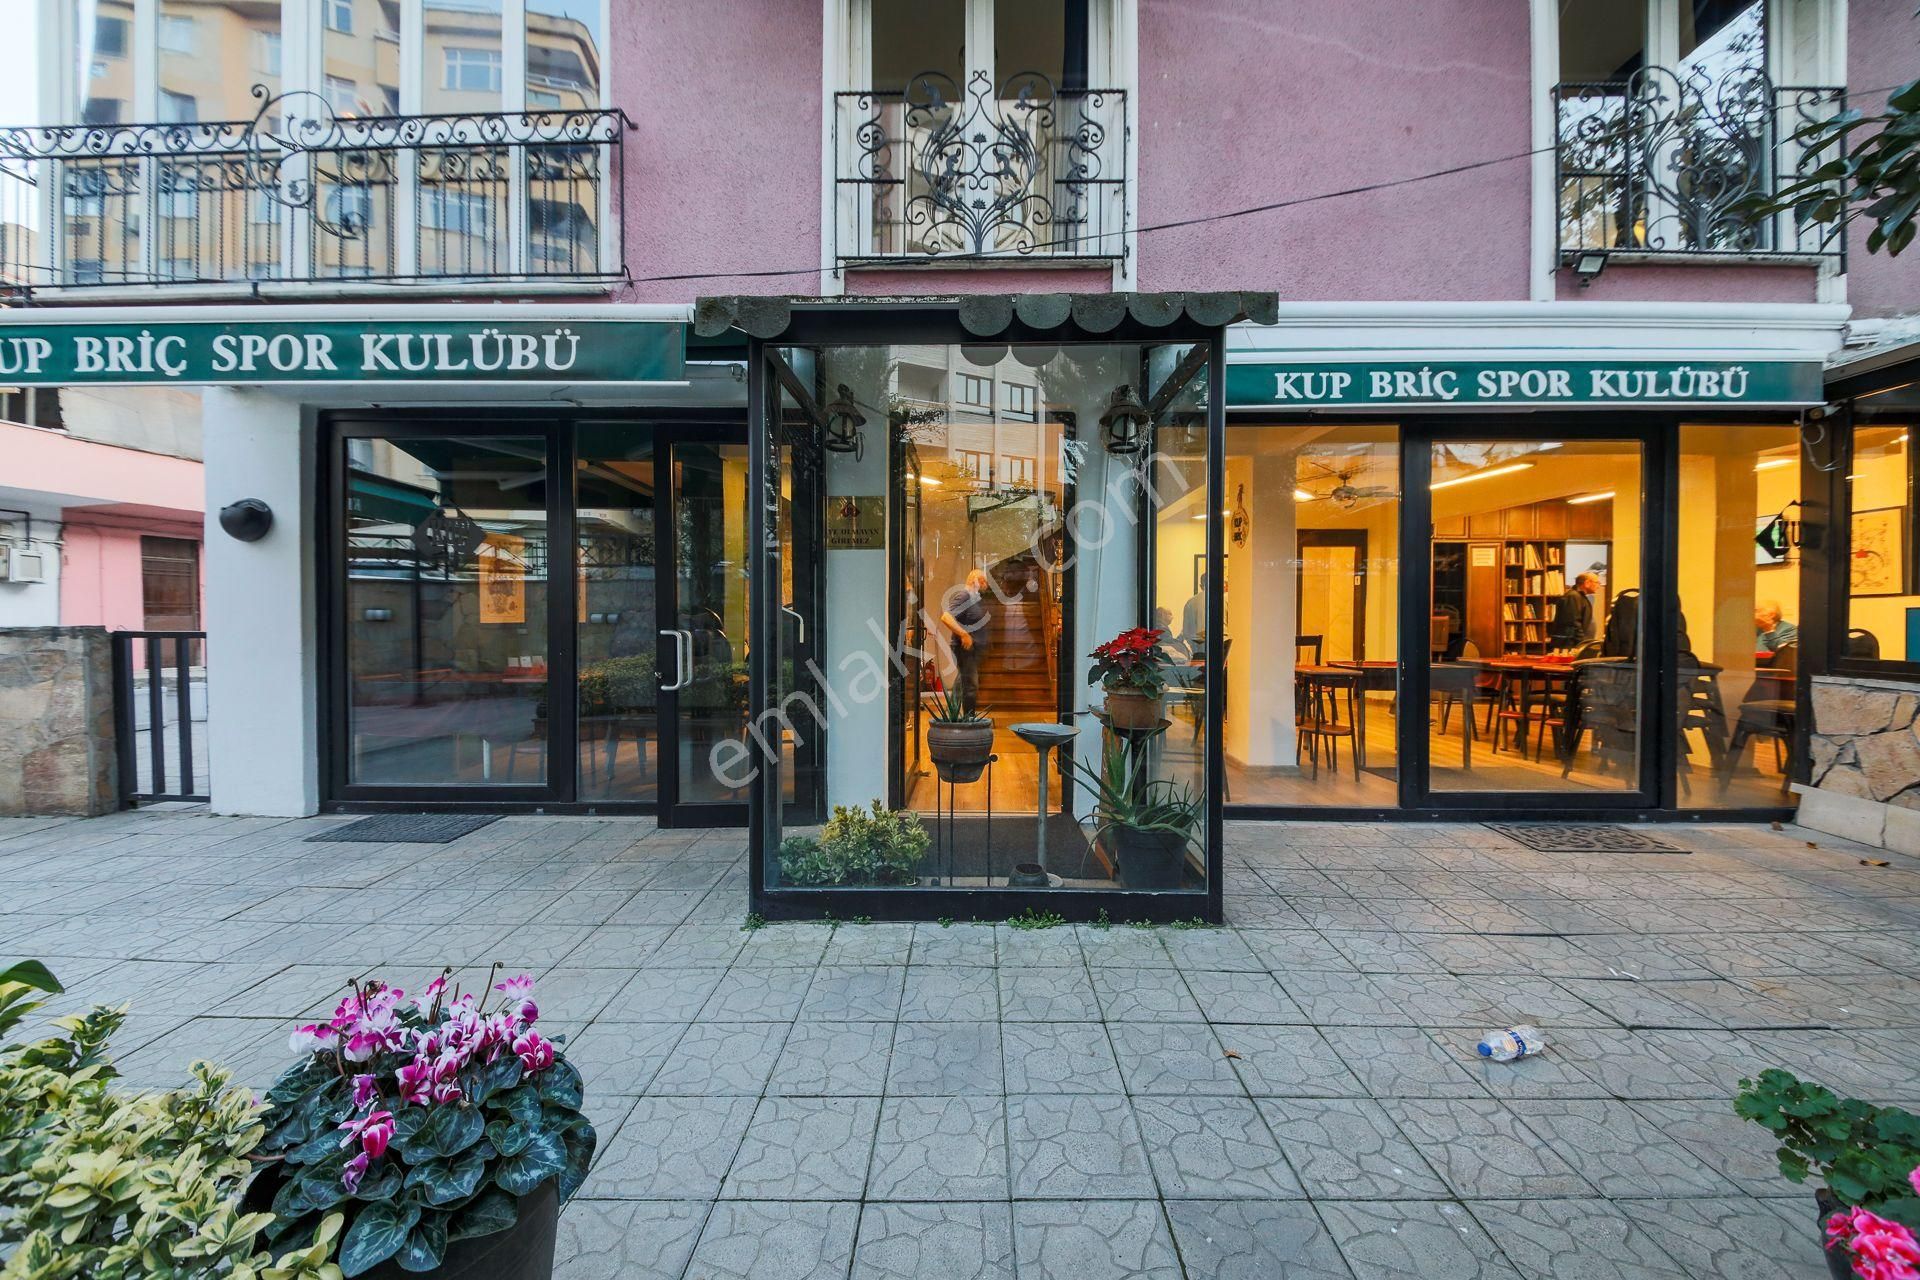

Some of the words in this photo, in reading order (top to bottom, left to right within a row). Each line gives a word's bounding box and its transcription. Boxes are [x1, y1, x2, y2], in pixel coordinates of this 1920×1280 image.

[0, 337, 52, 374] UP
[73, 330, 187, 376] BRİÇ
[212, 334, 338, 371] SPOR
[360, 329, 580, 371] KULÜBÜ
[1275, 372, 1352, 399] KUP
[1369, 366, 1460, 400] BRİÇ
[1477, 370, 1573, 398] SPOR
[1590, 366, 1749, 398] KULÜBÜ
